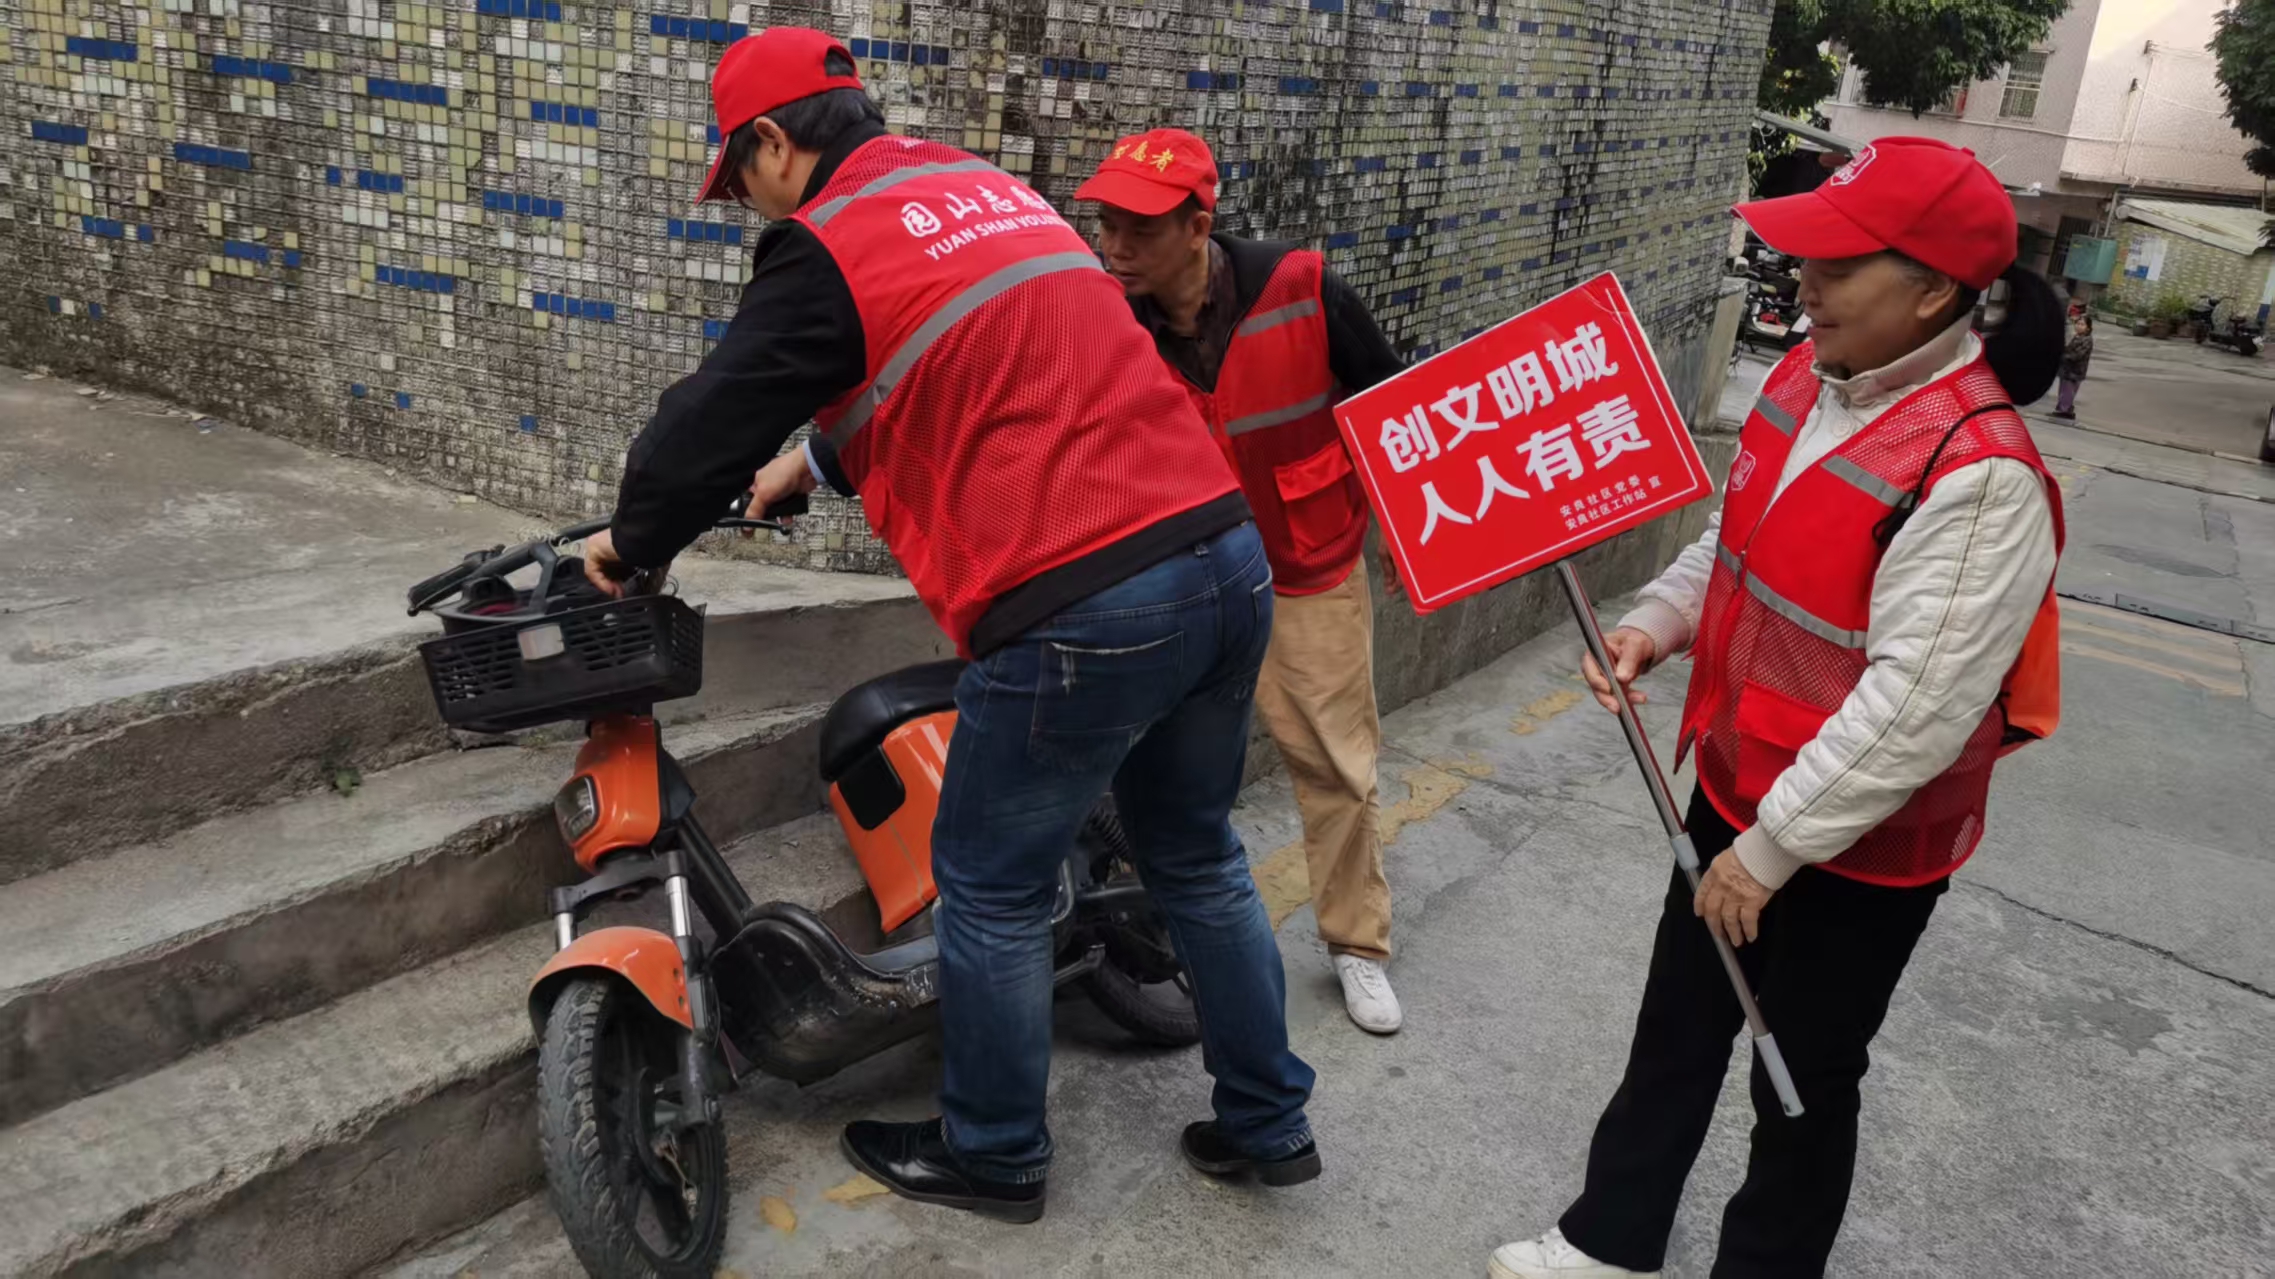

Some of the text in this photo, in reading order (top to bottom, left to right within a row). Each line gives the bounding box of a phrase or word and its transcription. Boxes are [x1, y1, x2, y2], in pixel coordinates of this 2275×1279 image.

[924, 228, 978, 261] YUAN
[974, 216, 1020, 237] SHAN
[1378, 320, 1620, 473] 创文明城
[1419, 394, 1652, 546] 人人有责
